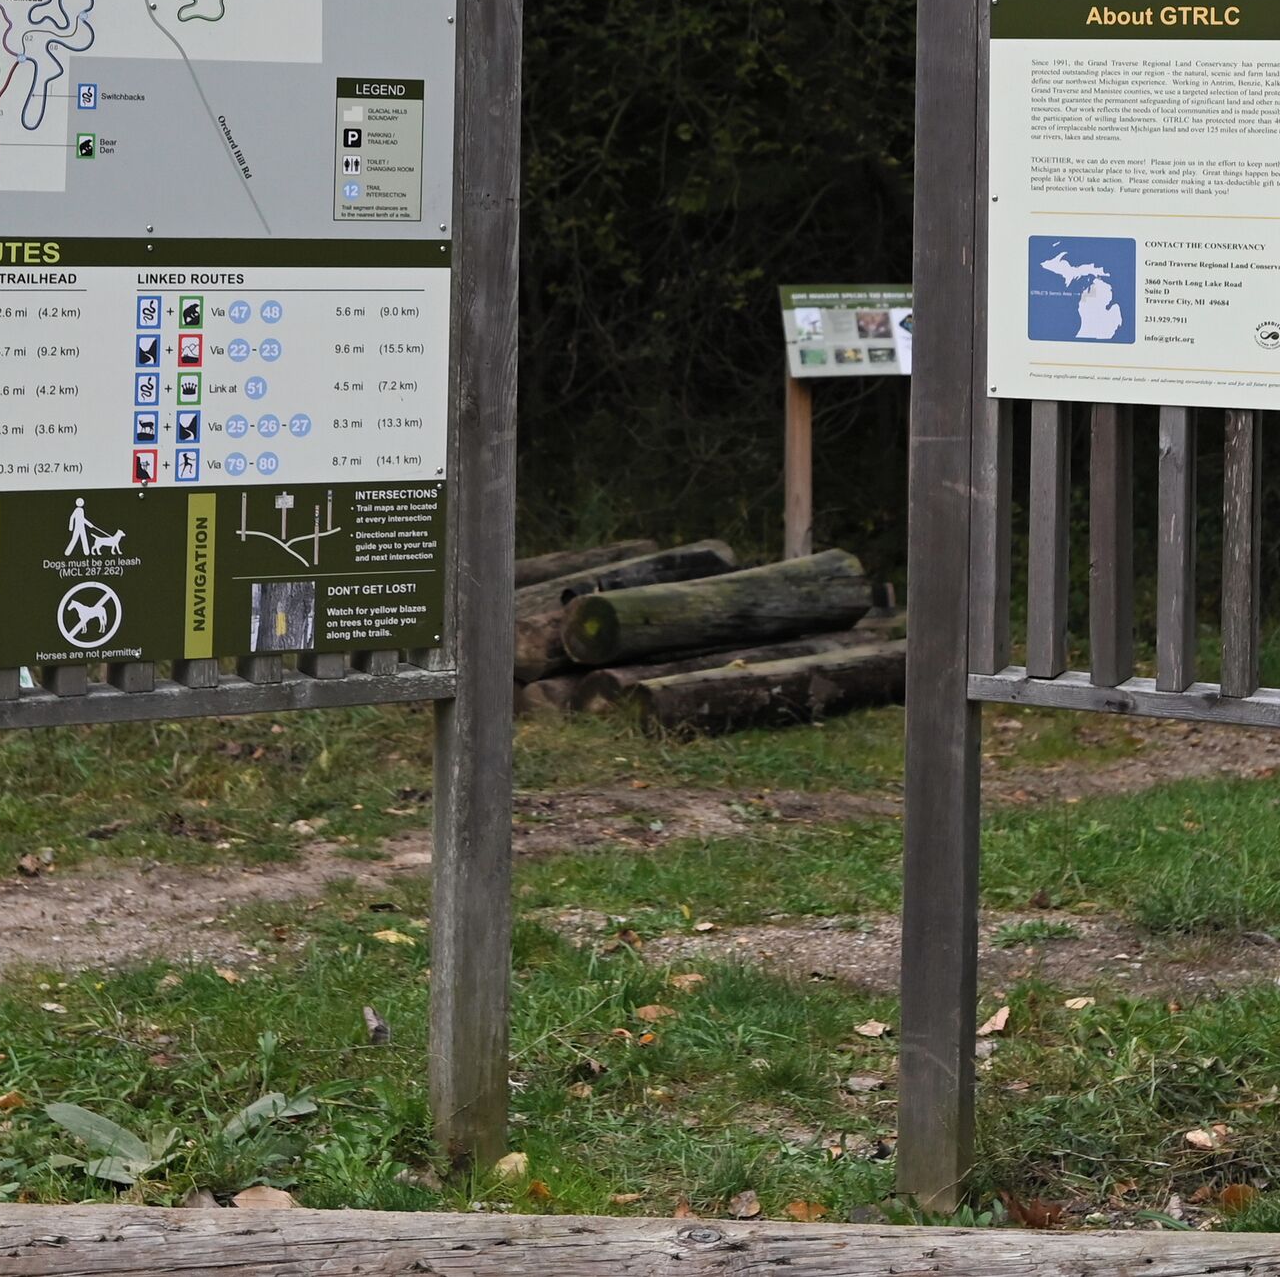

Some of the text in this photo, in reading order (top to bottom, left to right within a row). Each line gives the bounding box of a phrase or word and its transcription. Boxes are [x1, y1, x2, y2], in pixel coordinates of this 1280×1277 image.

[1086, 6, 1240, 25] About GTRLC
[356, 84, 405, 95] LEGEND
[100, 91, 146, 103] Switchbacks
[138, 273, 244, 284] LINKED ROUTES
[355, 489, 438, 500] INTERSECTIONS
[193, 517, 208, 631] NAVIGATION
[362, 584, 383, 594] GET
[386, 583, 416, 593] LOST!
